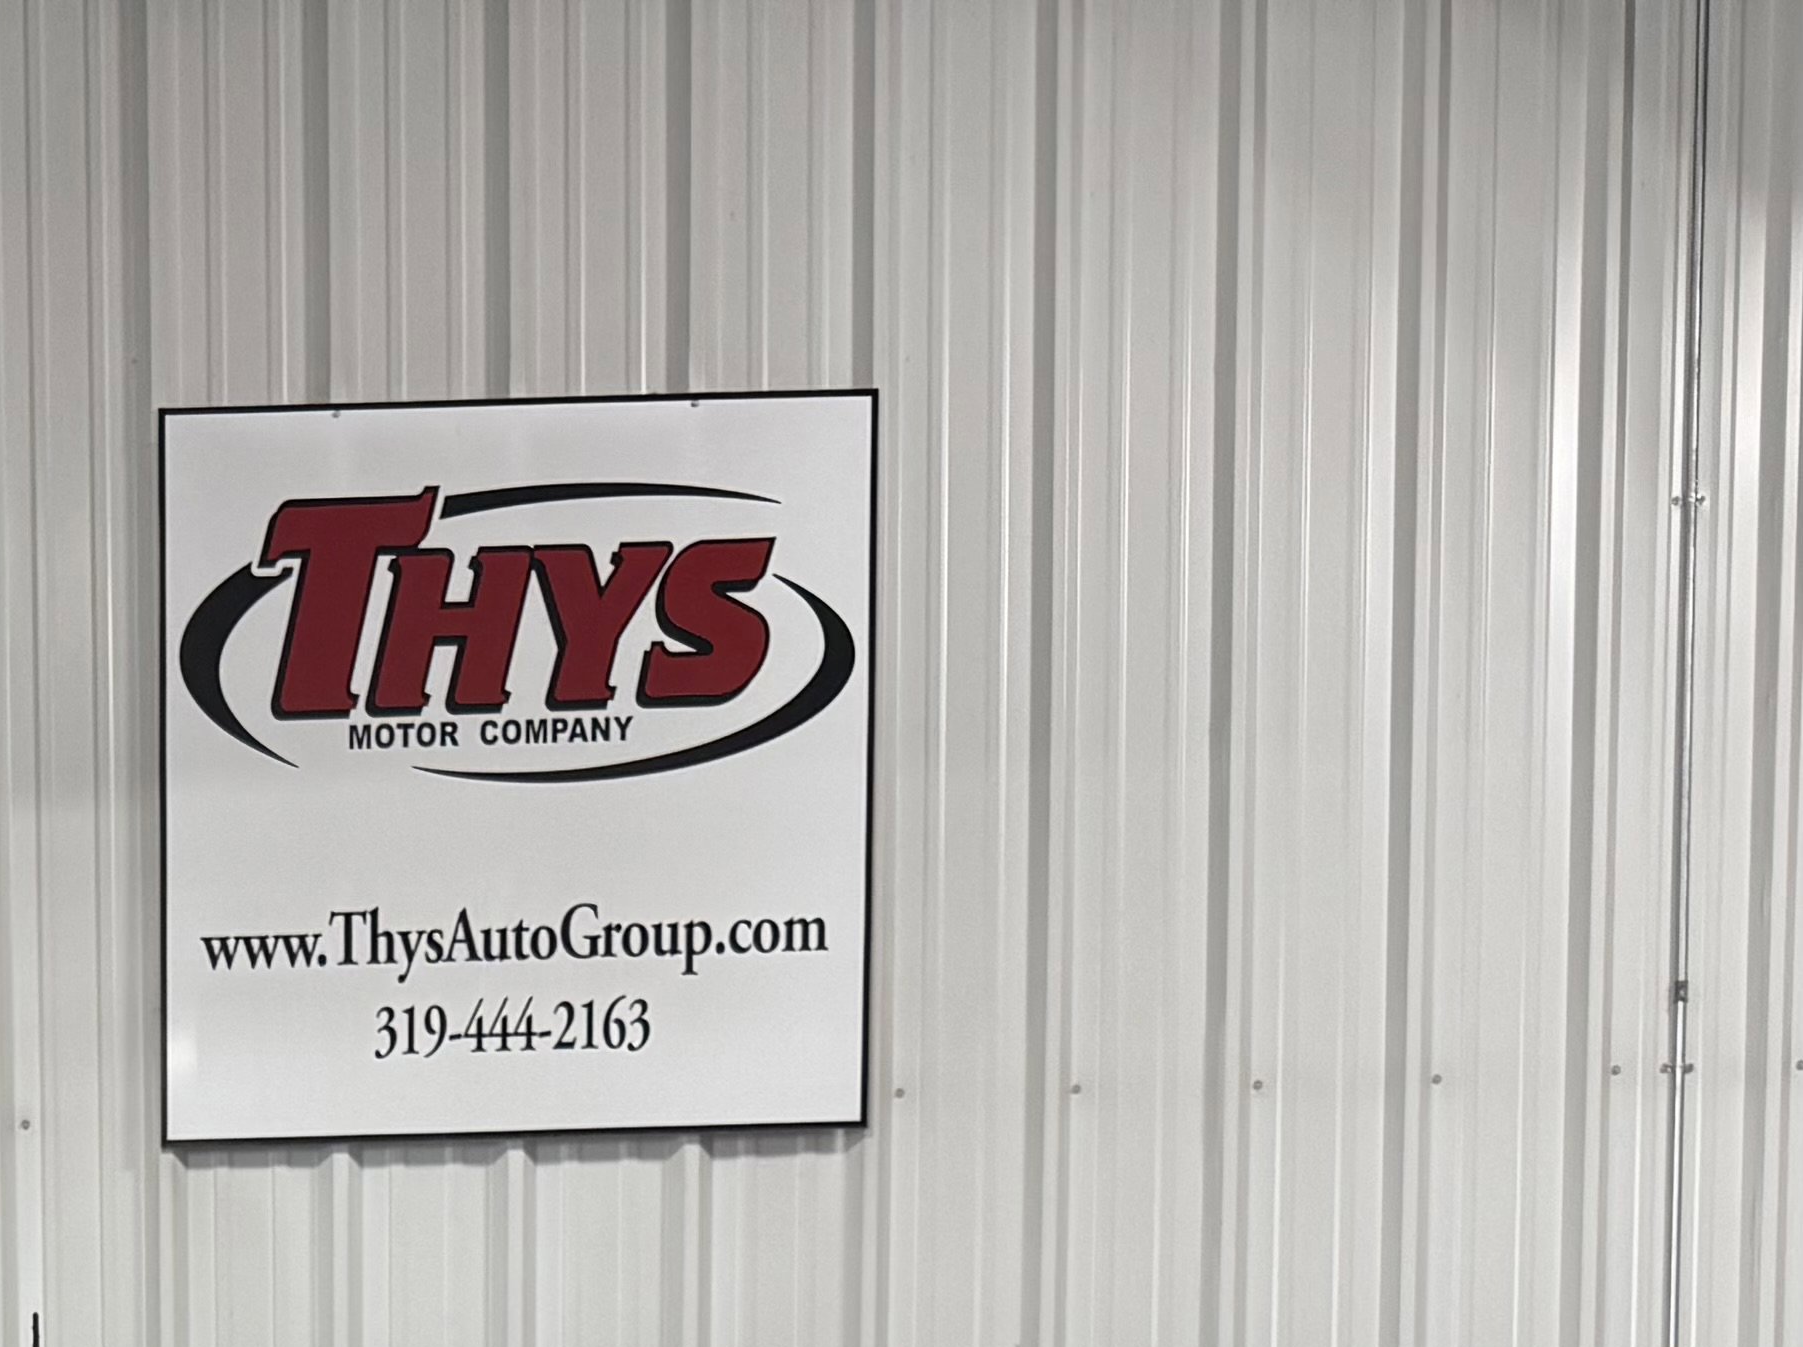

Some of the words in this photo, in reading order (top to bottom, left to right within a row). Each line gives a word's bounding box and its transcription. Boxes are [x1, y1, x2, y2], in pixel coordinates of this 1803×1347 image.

[257, 485, 776, 720] THYS
[348, 722, 459, 750] MOTOR
[479, 716, 633, 747] COMPANY
[201, 902, 829, 983] www.ThysAutoGroup.com
[374, 995, 651, 1059] 319-444-2163
